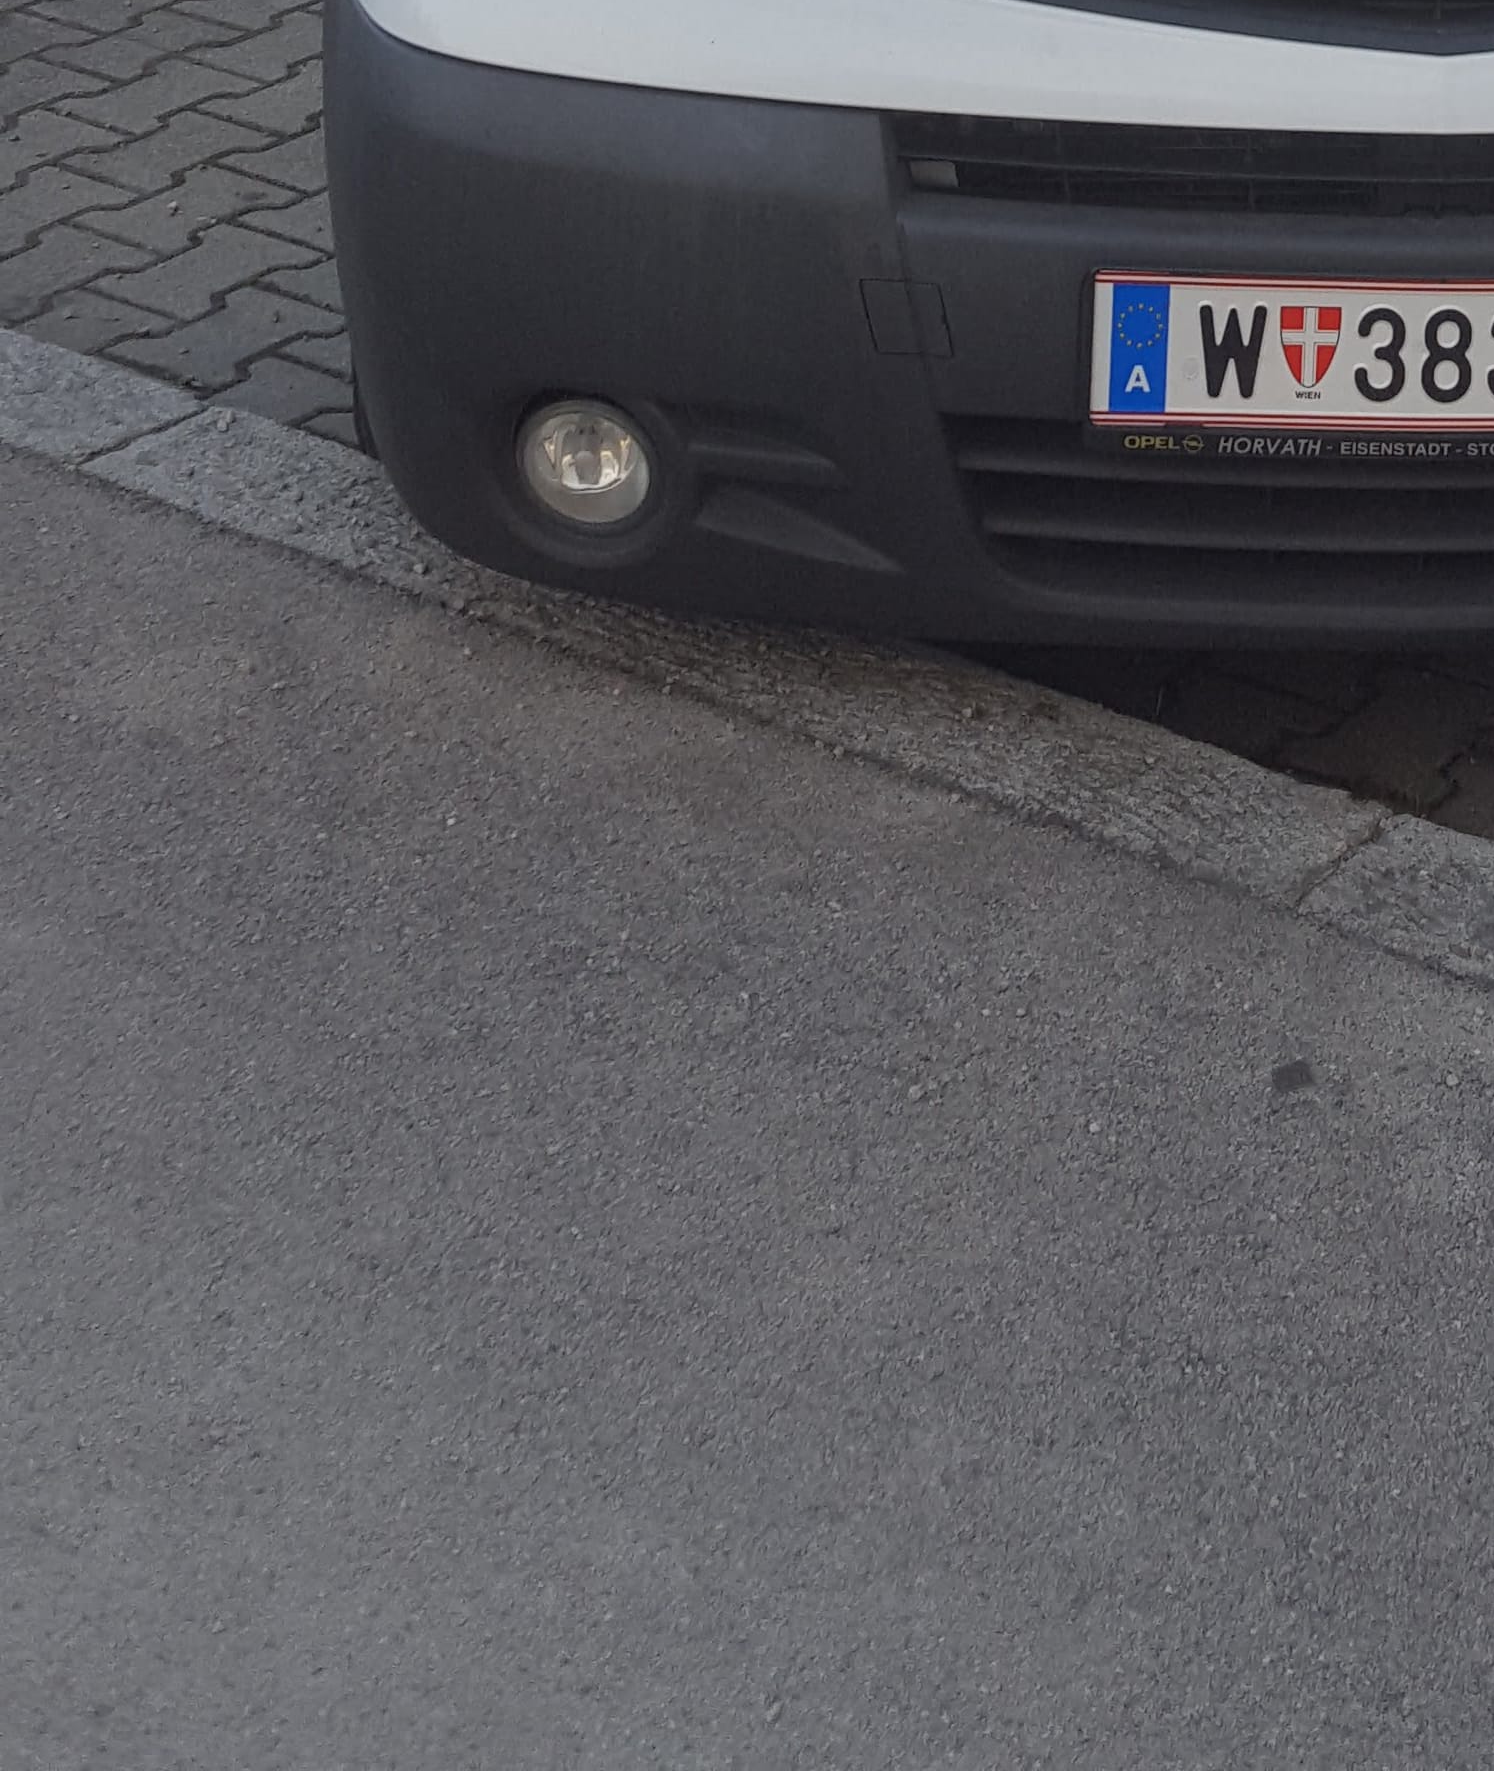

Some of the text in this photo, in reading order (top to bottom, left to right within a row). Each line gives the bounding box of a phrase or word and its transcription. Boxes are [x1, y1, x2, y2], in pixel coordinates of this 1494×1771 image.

[1199, 304, 1268, 399] W
[1123, 364, 1151, 393] A
[1295, 390, 1322, 401] WIEN
[1123, 434, 1181, 450] OPEL
[1217, 436, 1323, 457] HORVATH
[1340, 441, 1452, 457] EISENSTADT
